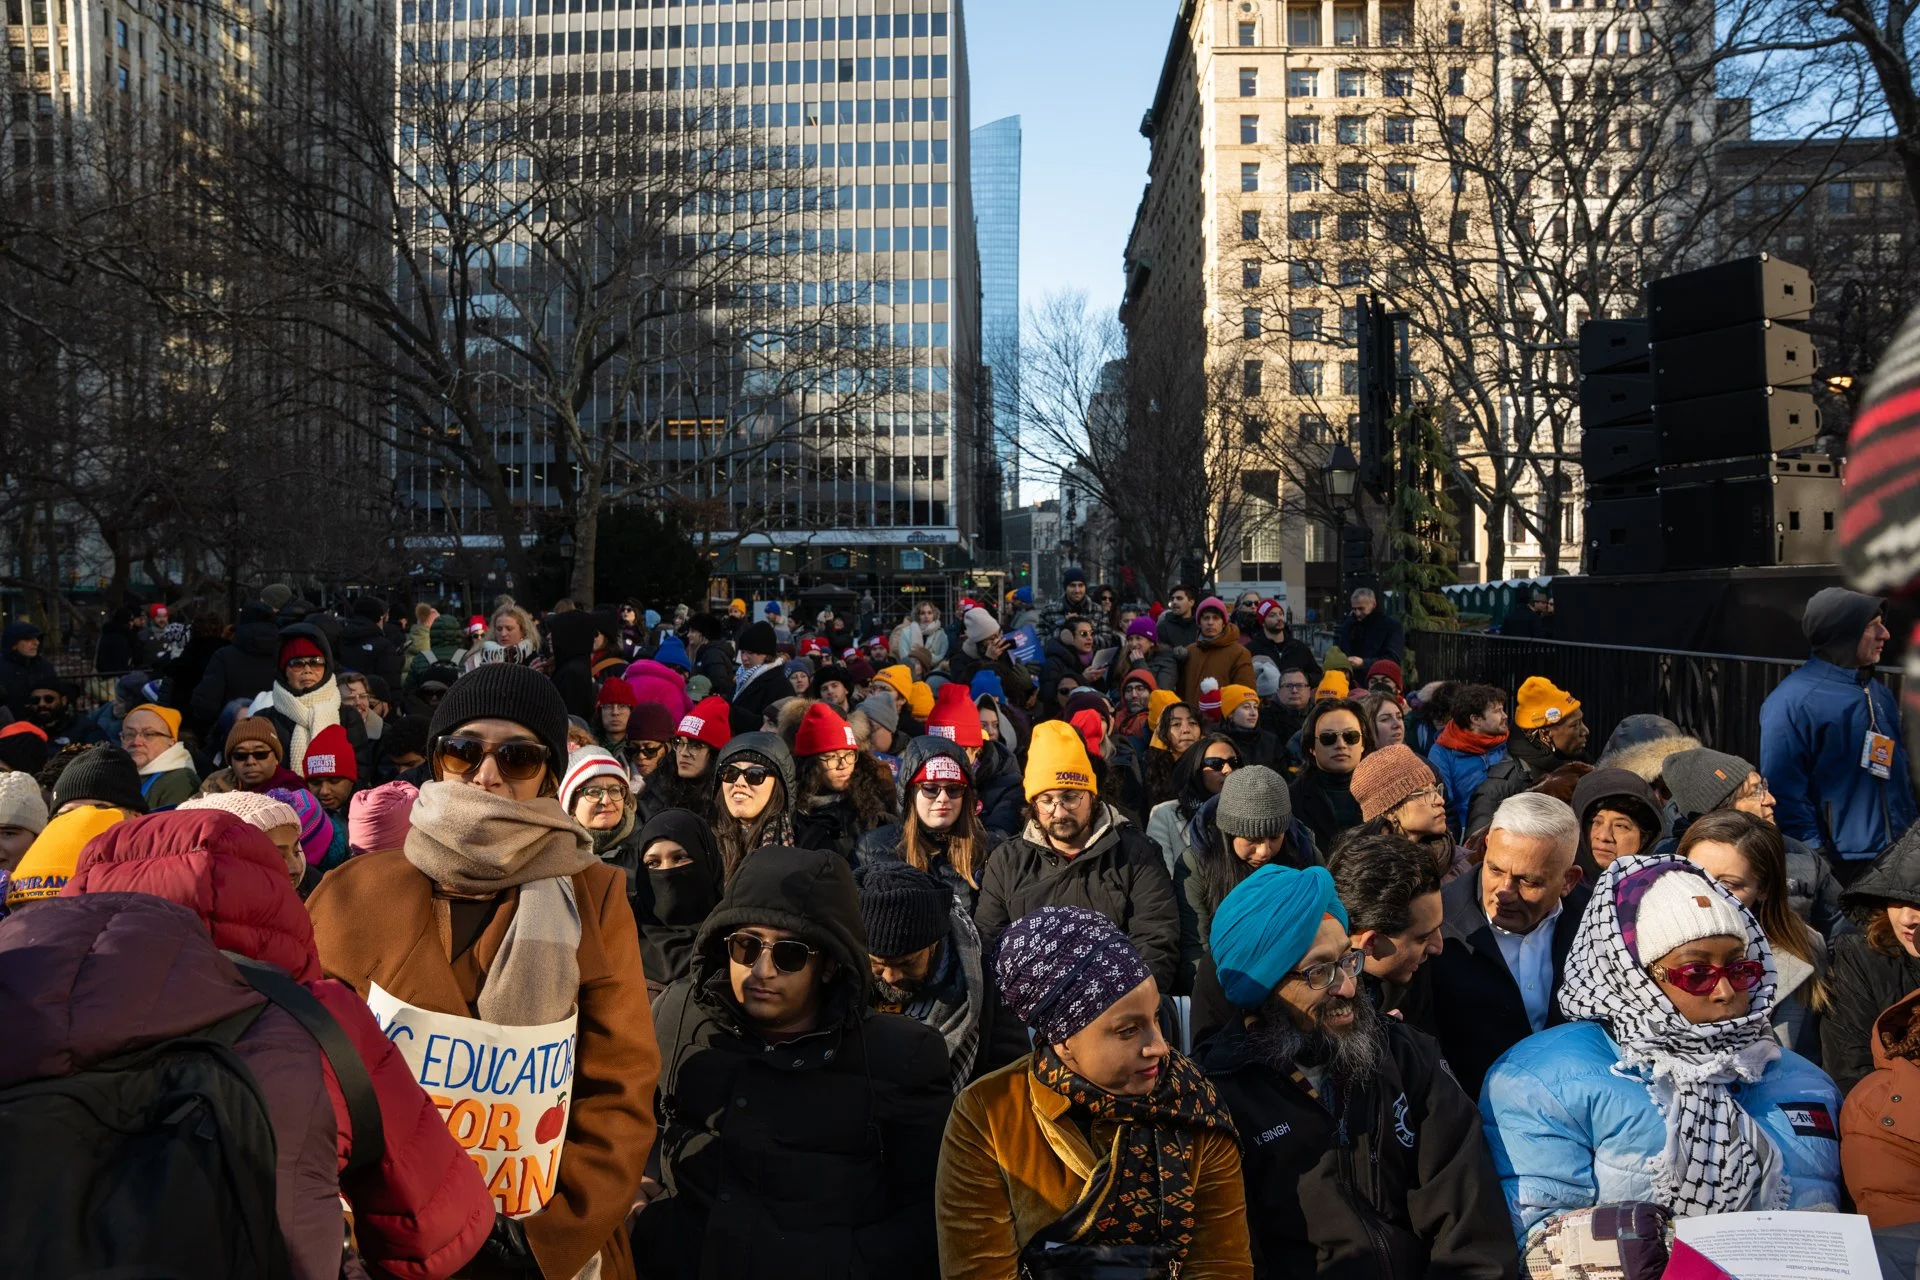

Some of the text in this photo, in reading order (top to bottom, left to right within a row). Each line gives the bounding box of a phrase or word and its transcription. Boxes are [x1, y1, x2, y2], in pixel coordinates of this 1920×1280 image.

[907, 533, 946, 543] citibank
[926, 761, 960, 772] SOCIALISTS
[926, 770, 961, 780] OF AMERICA
[1056, 771, 1089, 783] ZOHRAN
[1253, 1121, 1291, 1146] V. SINGH
